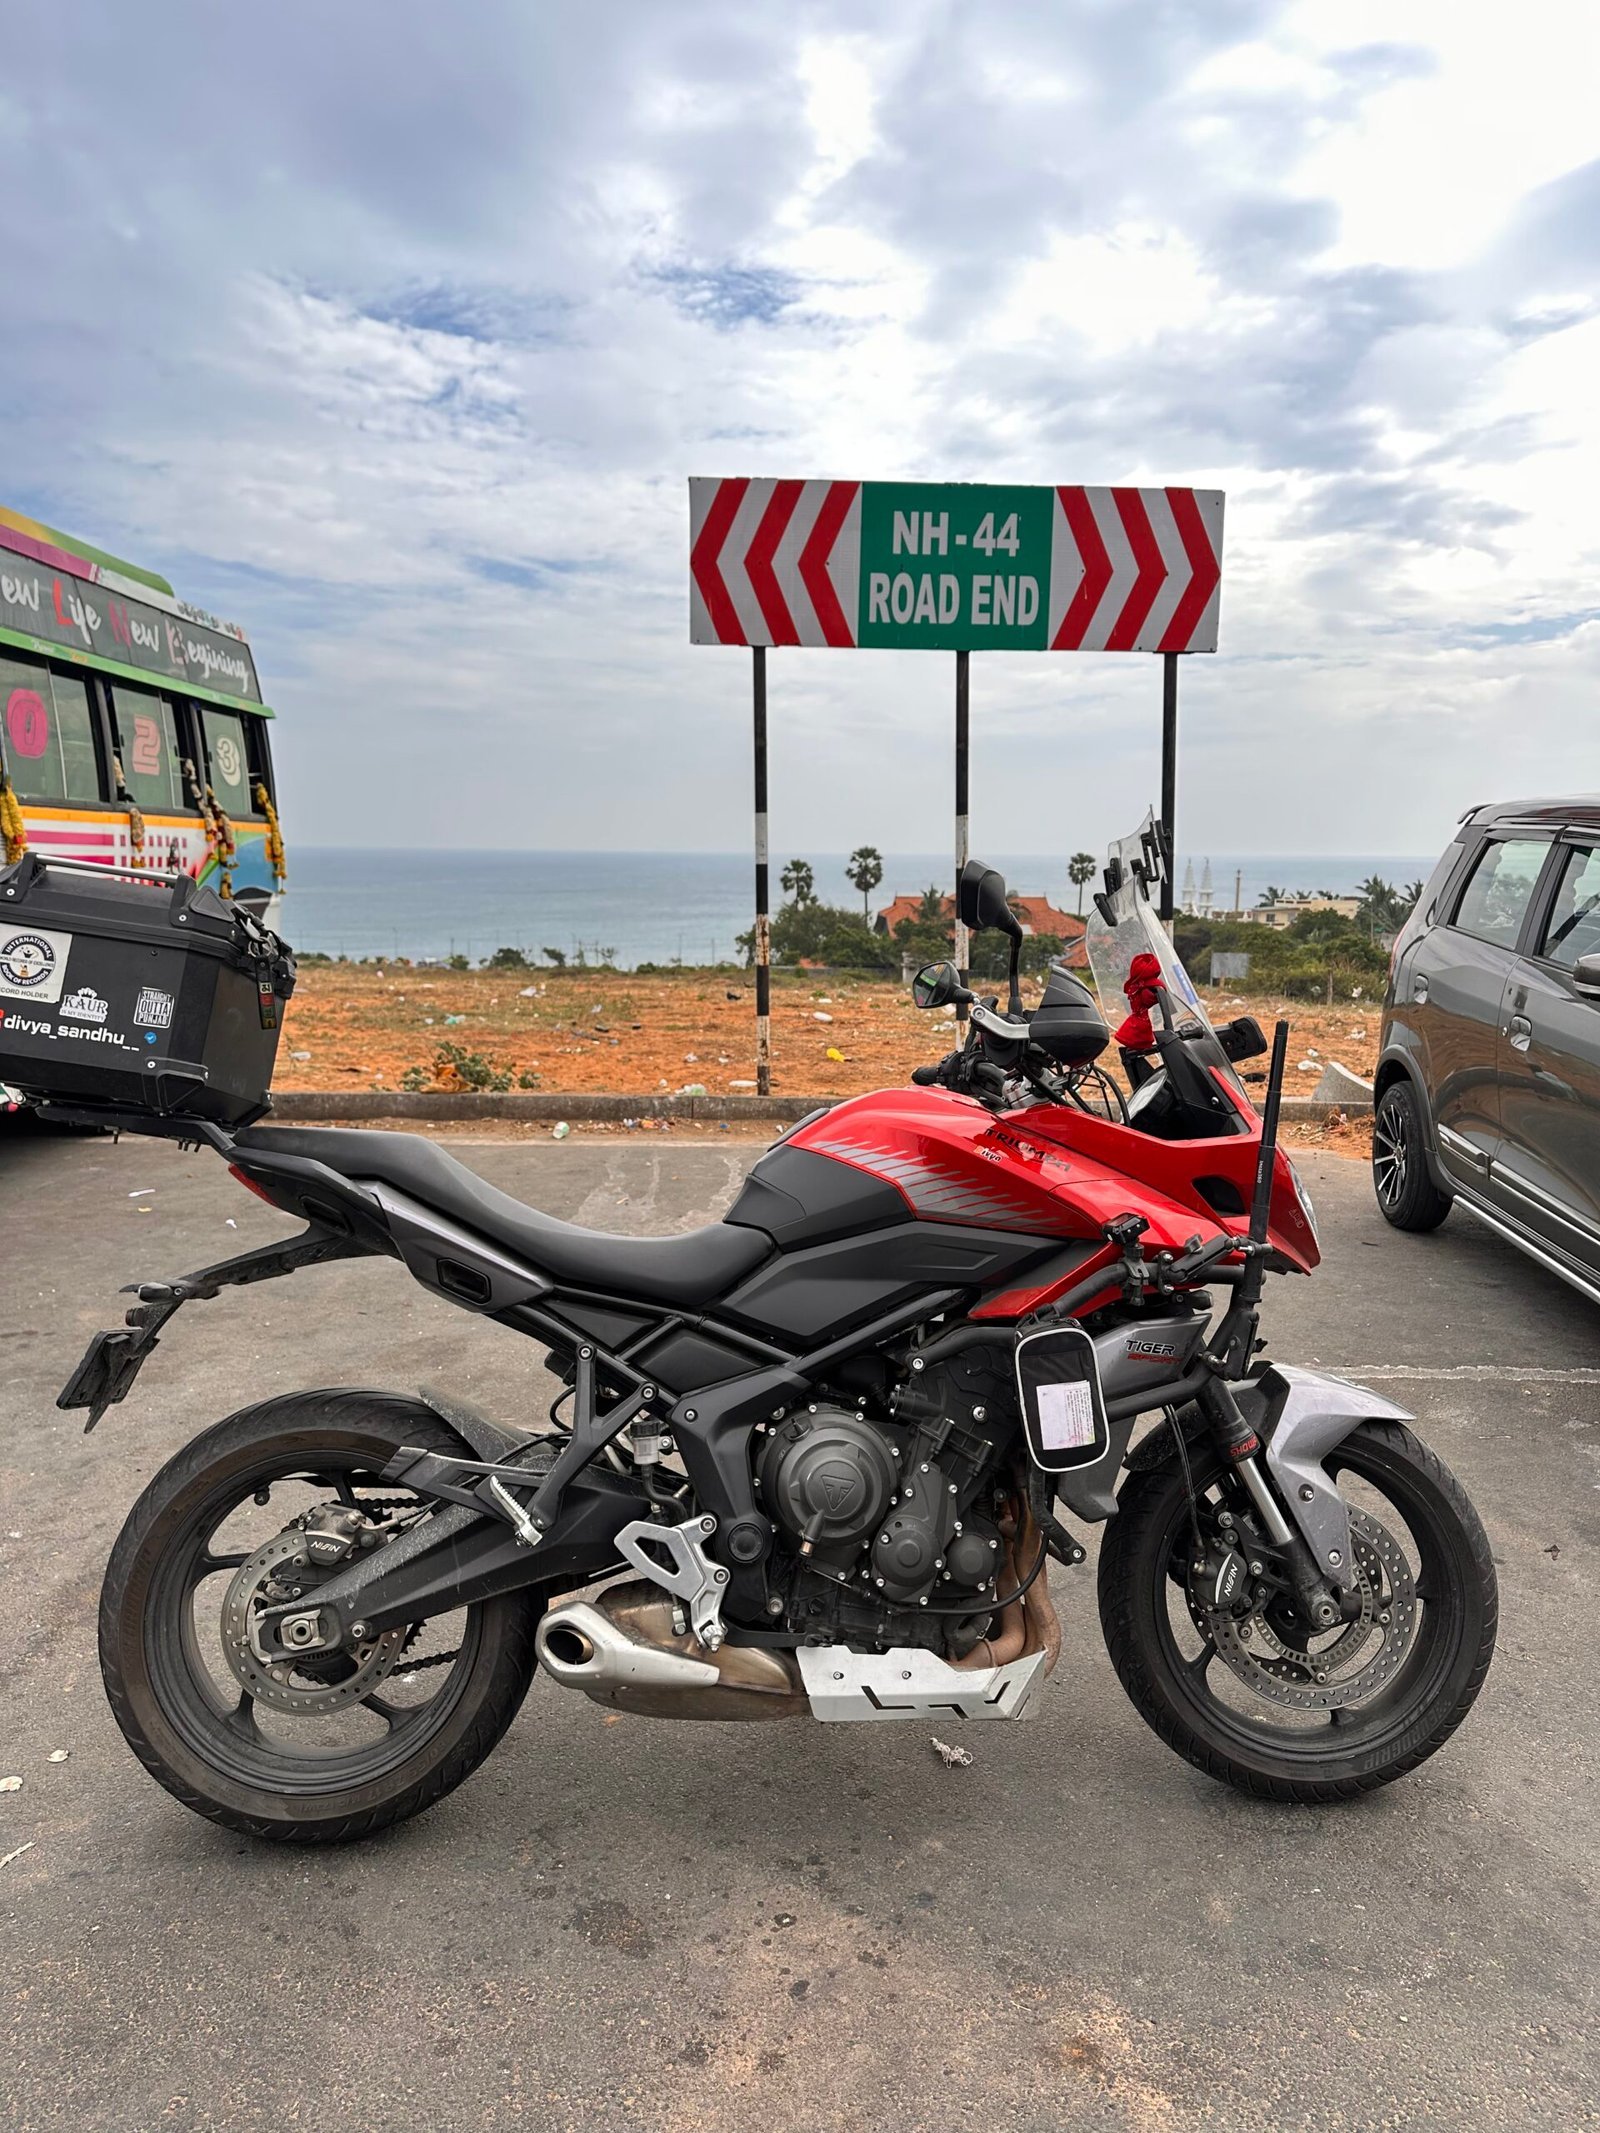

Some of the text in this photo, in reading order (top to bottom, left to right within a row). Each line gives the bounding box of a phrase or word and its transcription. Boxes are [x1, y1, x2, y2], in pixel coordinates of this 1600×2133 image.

[893, 510, 1020, 557] NH-44
[869, 572, 1039, 626] ROAD END
[1, 574, 39, 612] ew
[107, 599, 159, 653] New
[216, 734, 242, 787] 3
[5, 936, 53, 958] INTERNATIONAL
[21, 970, 49, 985] RECORDS
[0, 988, 49, 999] CORD HOLDER
[142, 990, 172, 1002] STRAIGHT
[64, 995, 108, 1014] KAUR
[140, 1001, 171, 1016] OUTTA
[138, 1013, 168, 1025] PUNJAB
[4, 1014, 139, 1051] divya_sandhu__
[1125, 1339, 1175, 1356] TIGER
